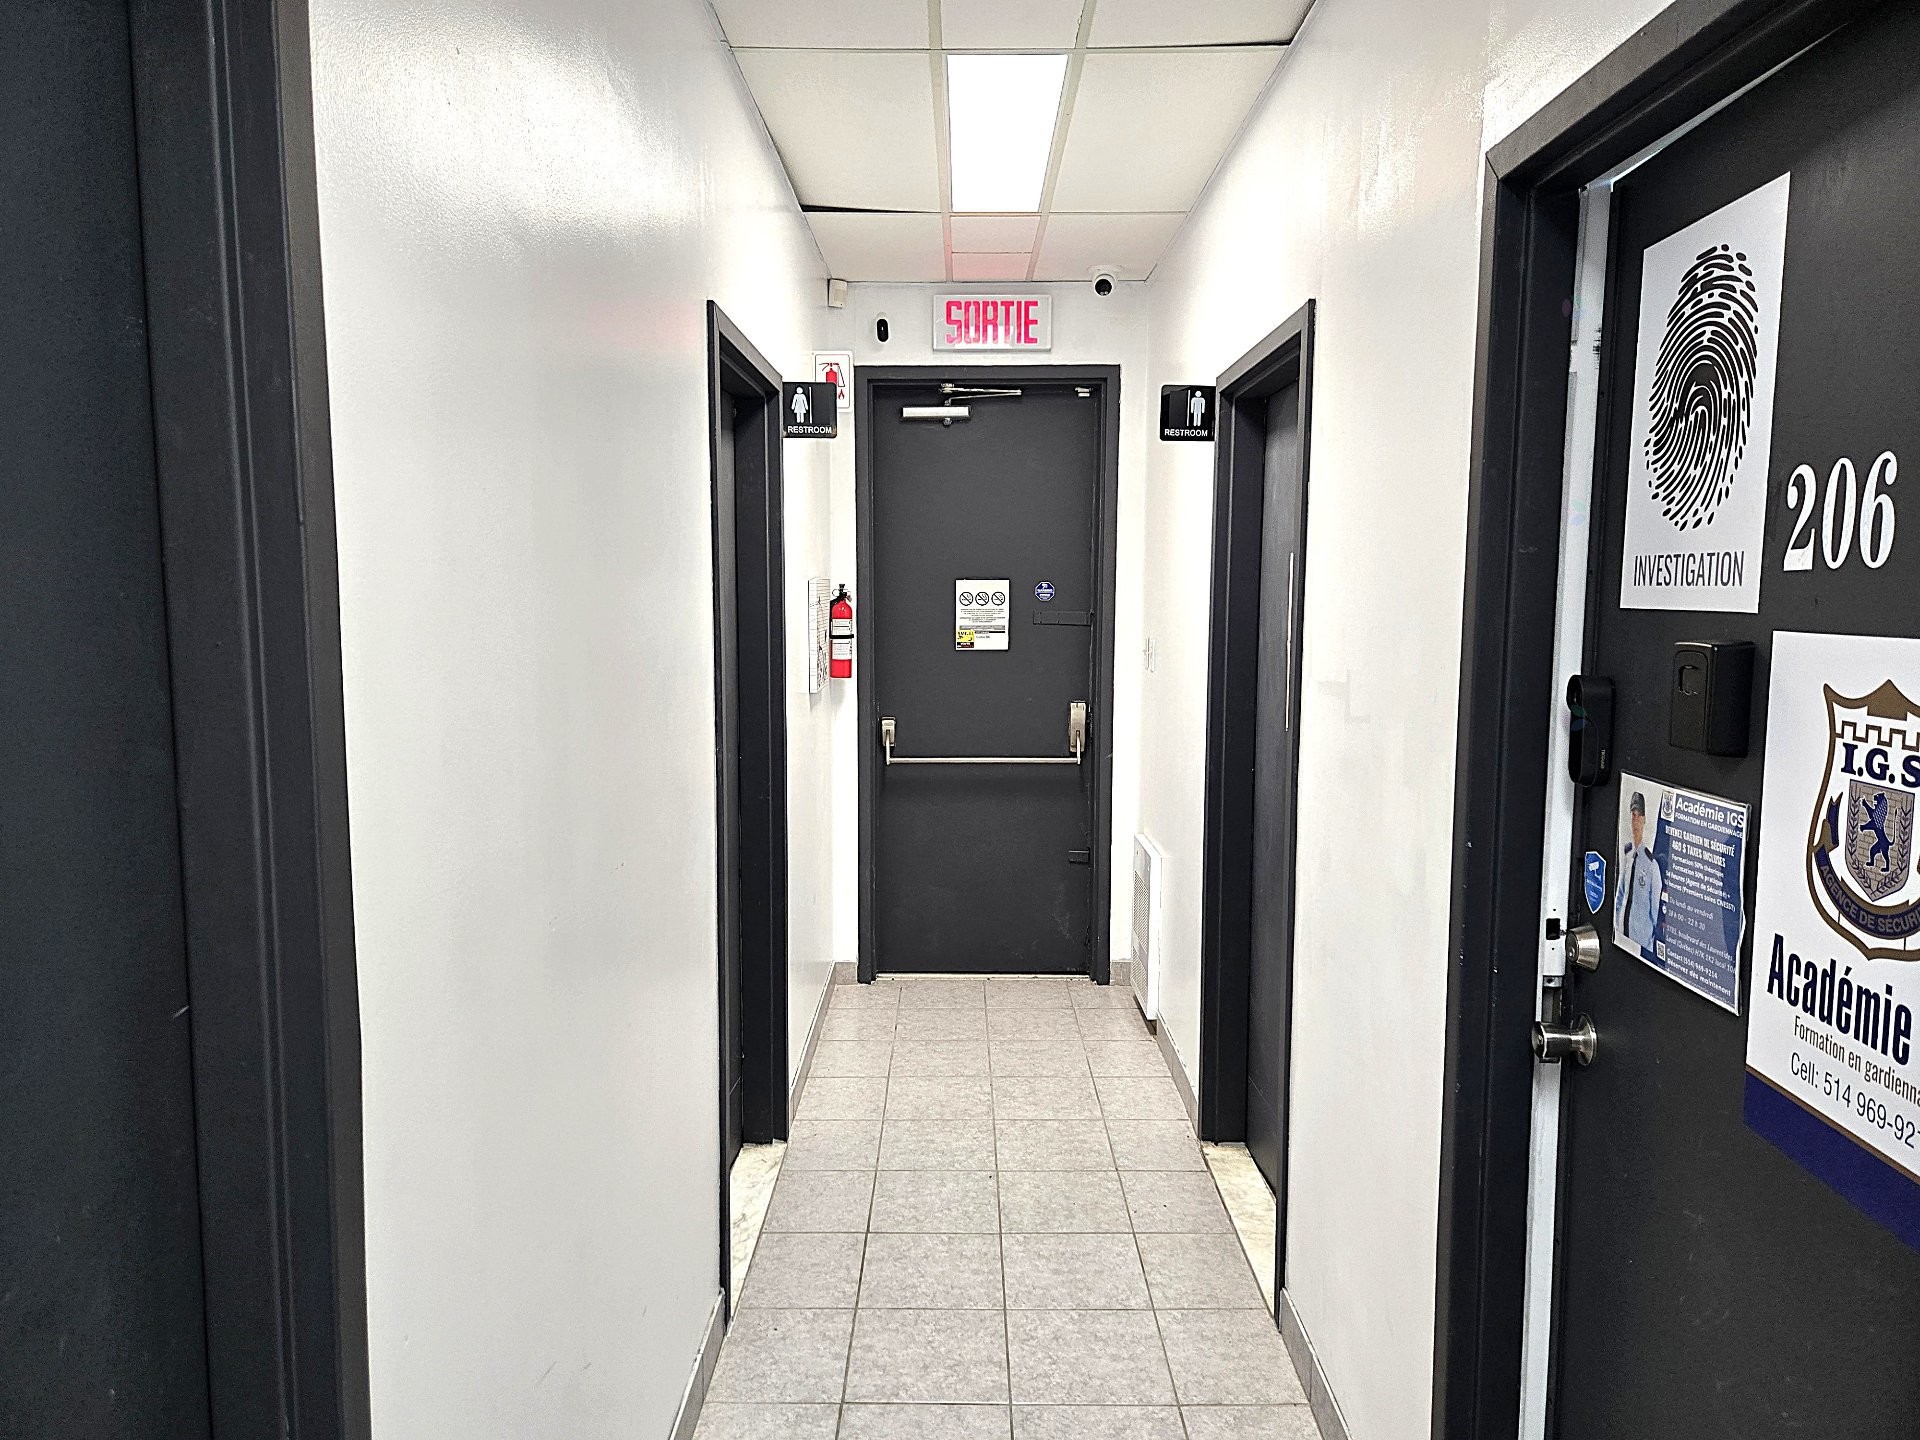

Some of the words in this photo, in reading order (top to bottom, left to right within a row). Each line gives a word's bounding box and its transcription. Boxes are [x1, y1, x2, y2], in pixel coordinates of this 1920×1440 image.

[945, 300, 1039, 344] SORTIE
[787, 425, 832, 434] RESTROOM
[1164, 428, 1208, 437] RESTROOM
[1783, 450, 1898, 570] 206
[1633, 551, 1745, 587] INVESTIGATION
[1675, 812, 1700, 826] FORMATION
[1700, 820, 1707, 829] EN
[1707, 822, 1743, 839] GARDIENNAGE
[1676, 797, 1724, 822] Académie
[1726, 811, 1744, 828] IGS
[1687, 845, 1702, 859] TAXES
[1710, 839, 1736, 857] SÉCURITÉ
[1821, 866, 1859, 918] AGENCE
[1859, 911, 1875, 929] DE
[1877, 907, 1920, 933] SÉCURI
[1766, 933, 1912, 1066] Académie
[1794, 1015, 1845, 1064] Formation
[1849, 1050, 1861, 1074] en
[1791, 1052, 1818, 1089] Cell:
[1823, 1071, 1851, 1109] 514
[1856, 1091, 1920, 1150] 969-92
